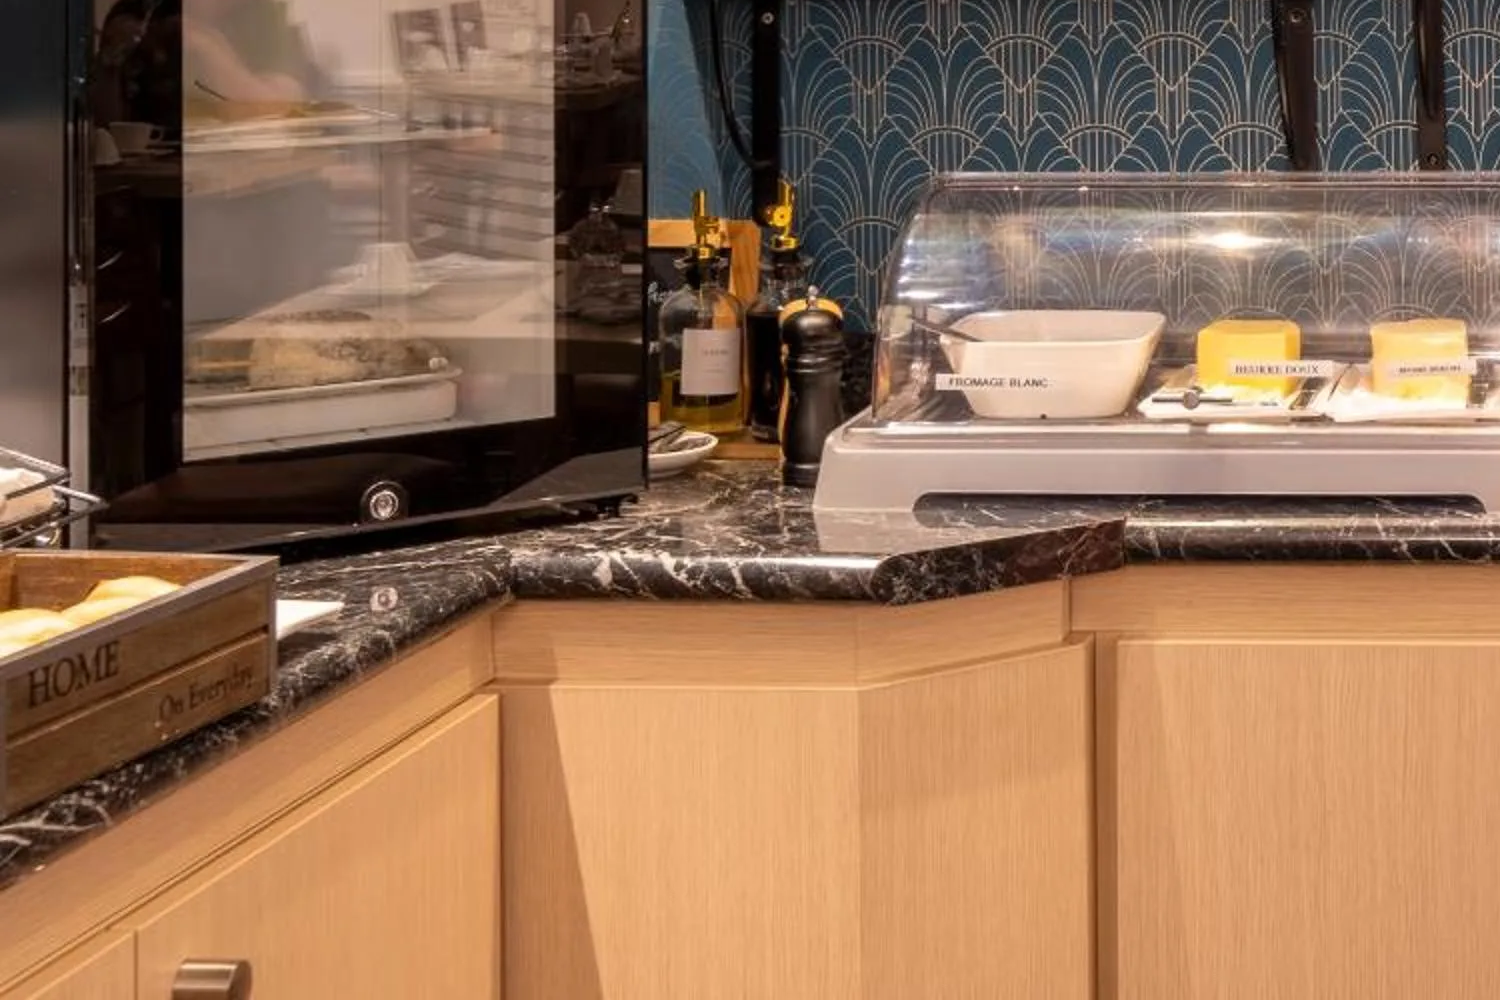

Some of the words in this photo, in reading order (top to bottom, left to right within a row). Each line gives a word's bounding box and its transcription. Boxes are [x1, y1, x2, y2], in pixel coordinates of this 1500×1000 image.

[948, 376, 1006, 388] FROMAGE
[1009, 377, 1049, 389] BLANC
[28, 640, 121, 710] HOME
